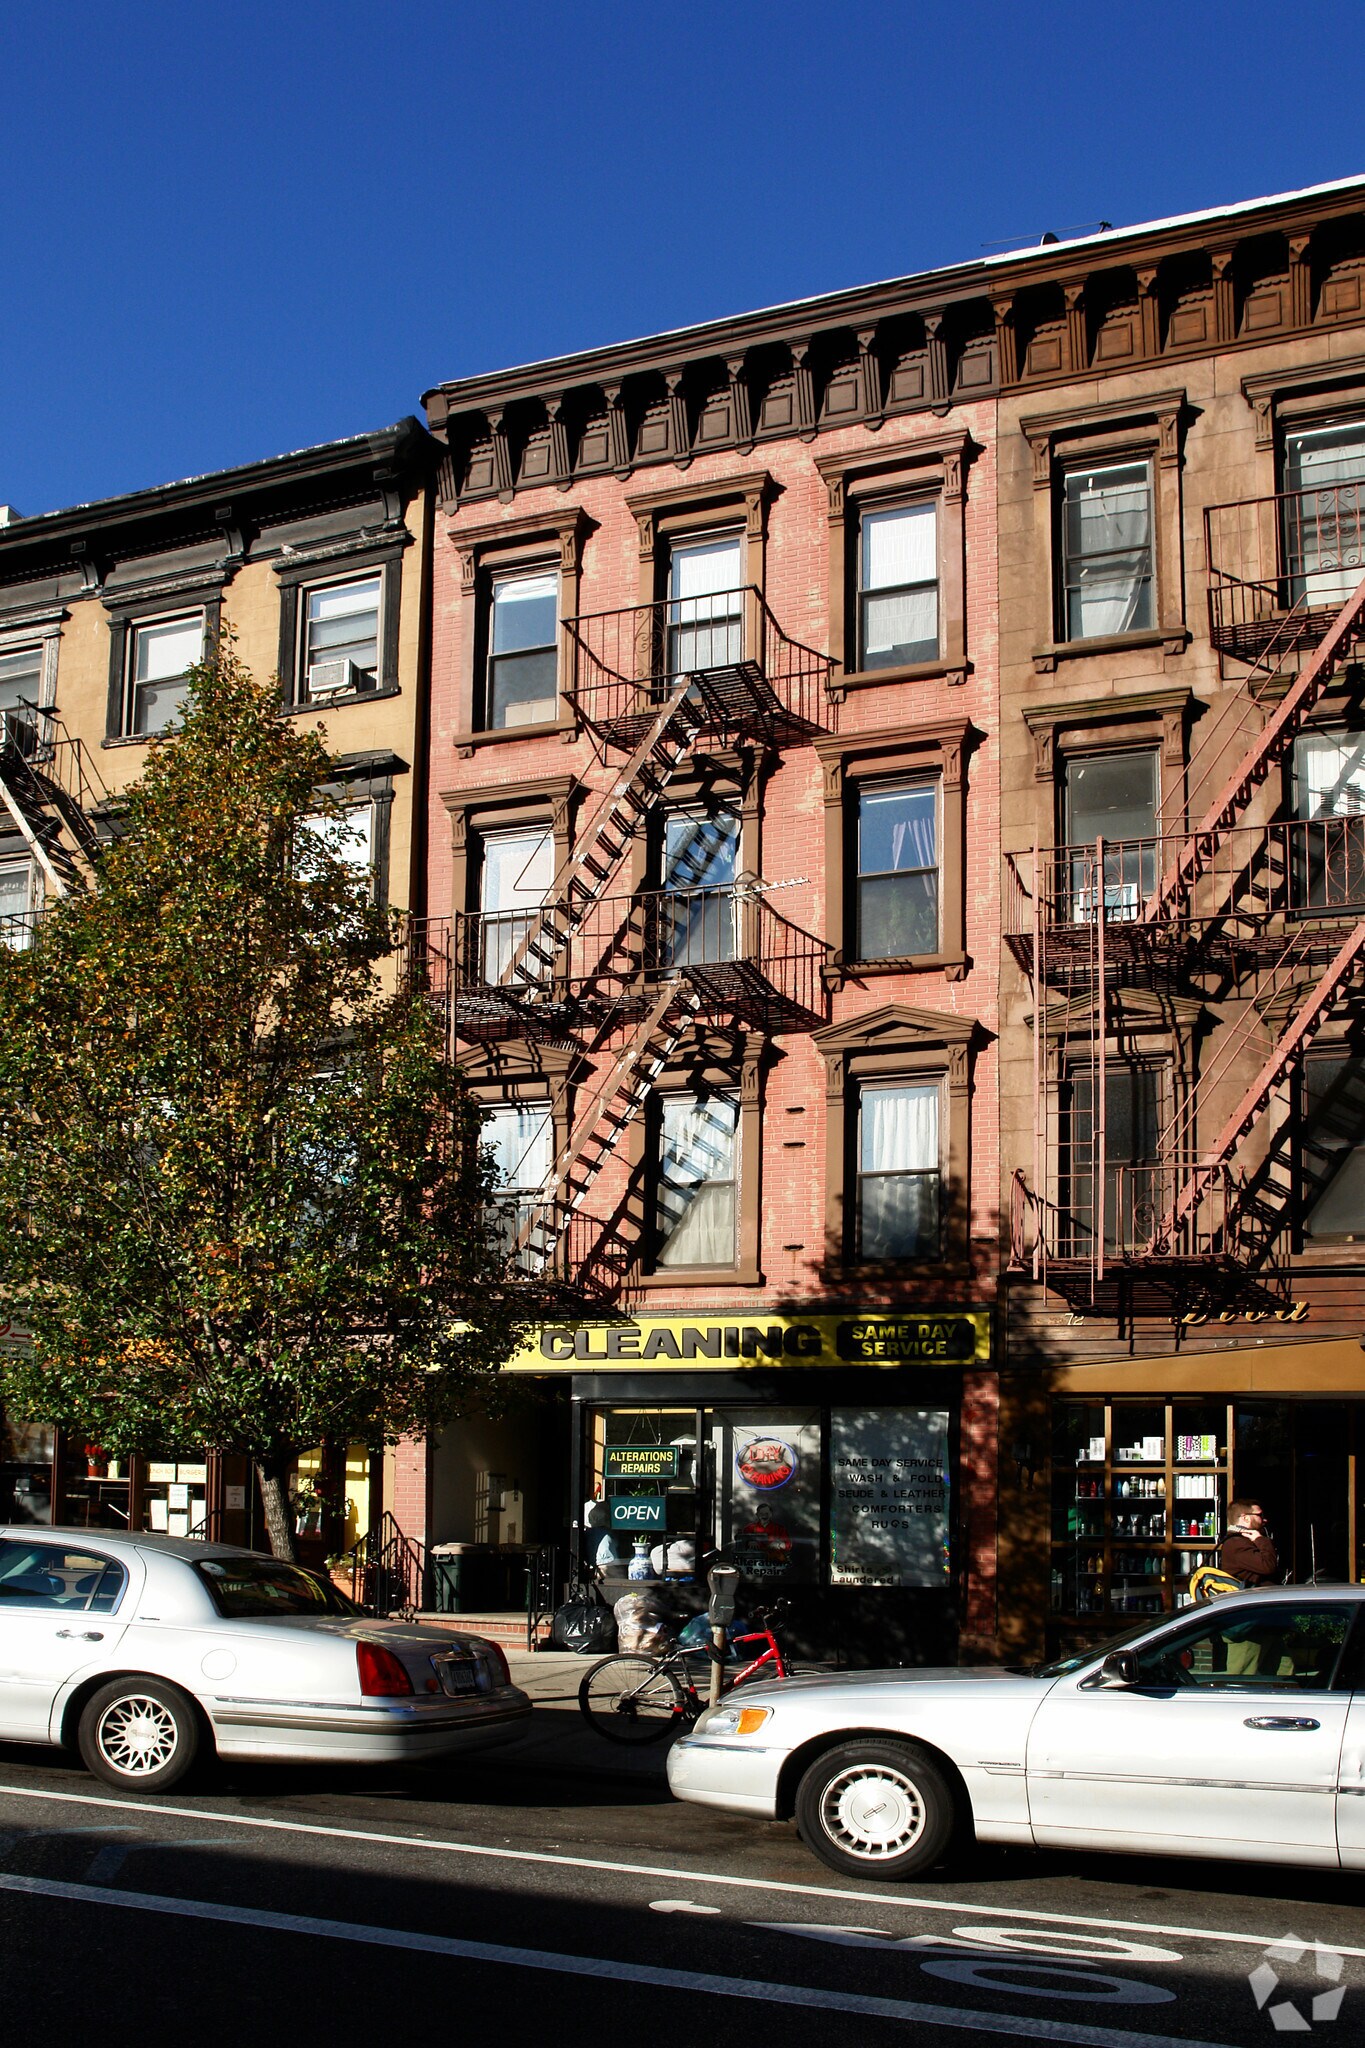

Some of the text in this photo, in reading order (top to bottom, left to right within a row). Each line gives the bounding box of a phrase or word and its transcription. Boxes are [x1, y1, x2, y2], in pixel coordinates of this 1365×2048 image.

[1064, 1312, 1085, 1326] 72
[852, 1324, 957, 1340] SAME DAY
[540, 1324, 822, 1361] CLEANING
[861, 1341, 947, 1356] SERVICE
[610, 1451, 673, 1462] ALTERATIONS
[750, 1445, 785, 1463] DRY
[621, 1463, 661, 1473] REPAIRS
[838, 1459, 943, 1468] SAME DAY SERVICE
[740, 1463, 791, 1485] CLEANING
[849, 1474, 943, 1483] WASH & FOLD
[838, 1489, 946, 1498] SEUDE & LEATHER
[614, 1505, 660, 1520] OPEN
[852, 1505, 942, 1513] COMFORTERS
[871, 1520, 909, 1529] RUGS
[746, 1567, 786, 1577] Repairs
[837, 1565, 872, 1574] Shirts
[832, 1575, 894, 1584] Laundered
